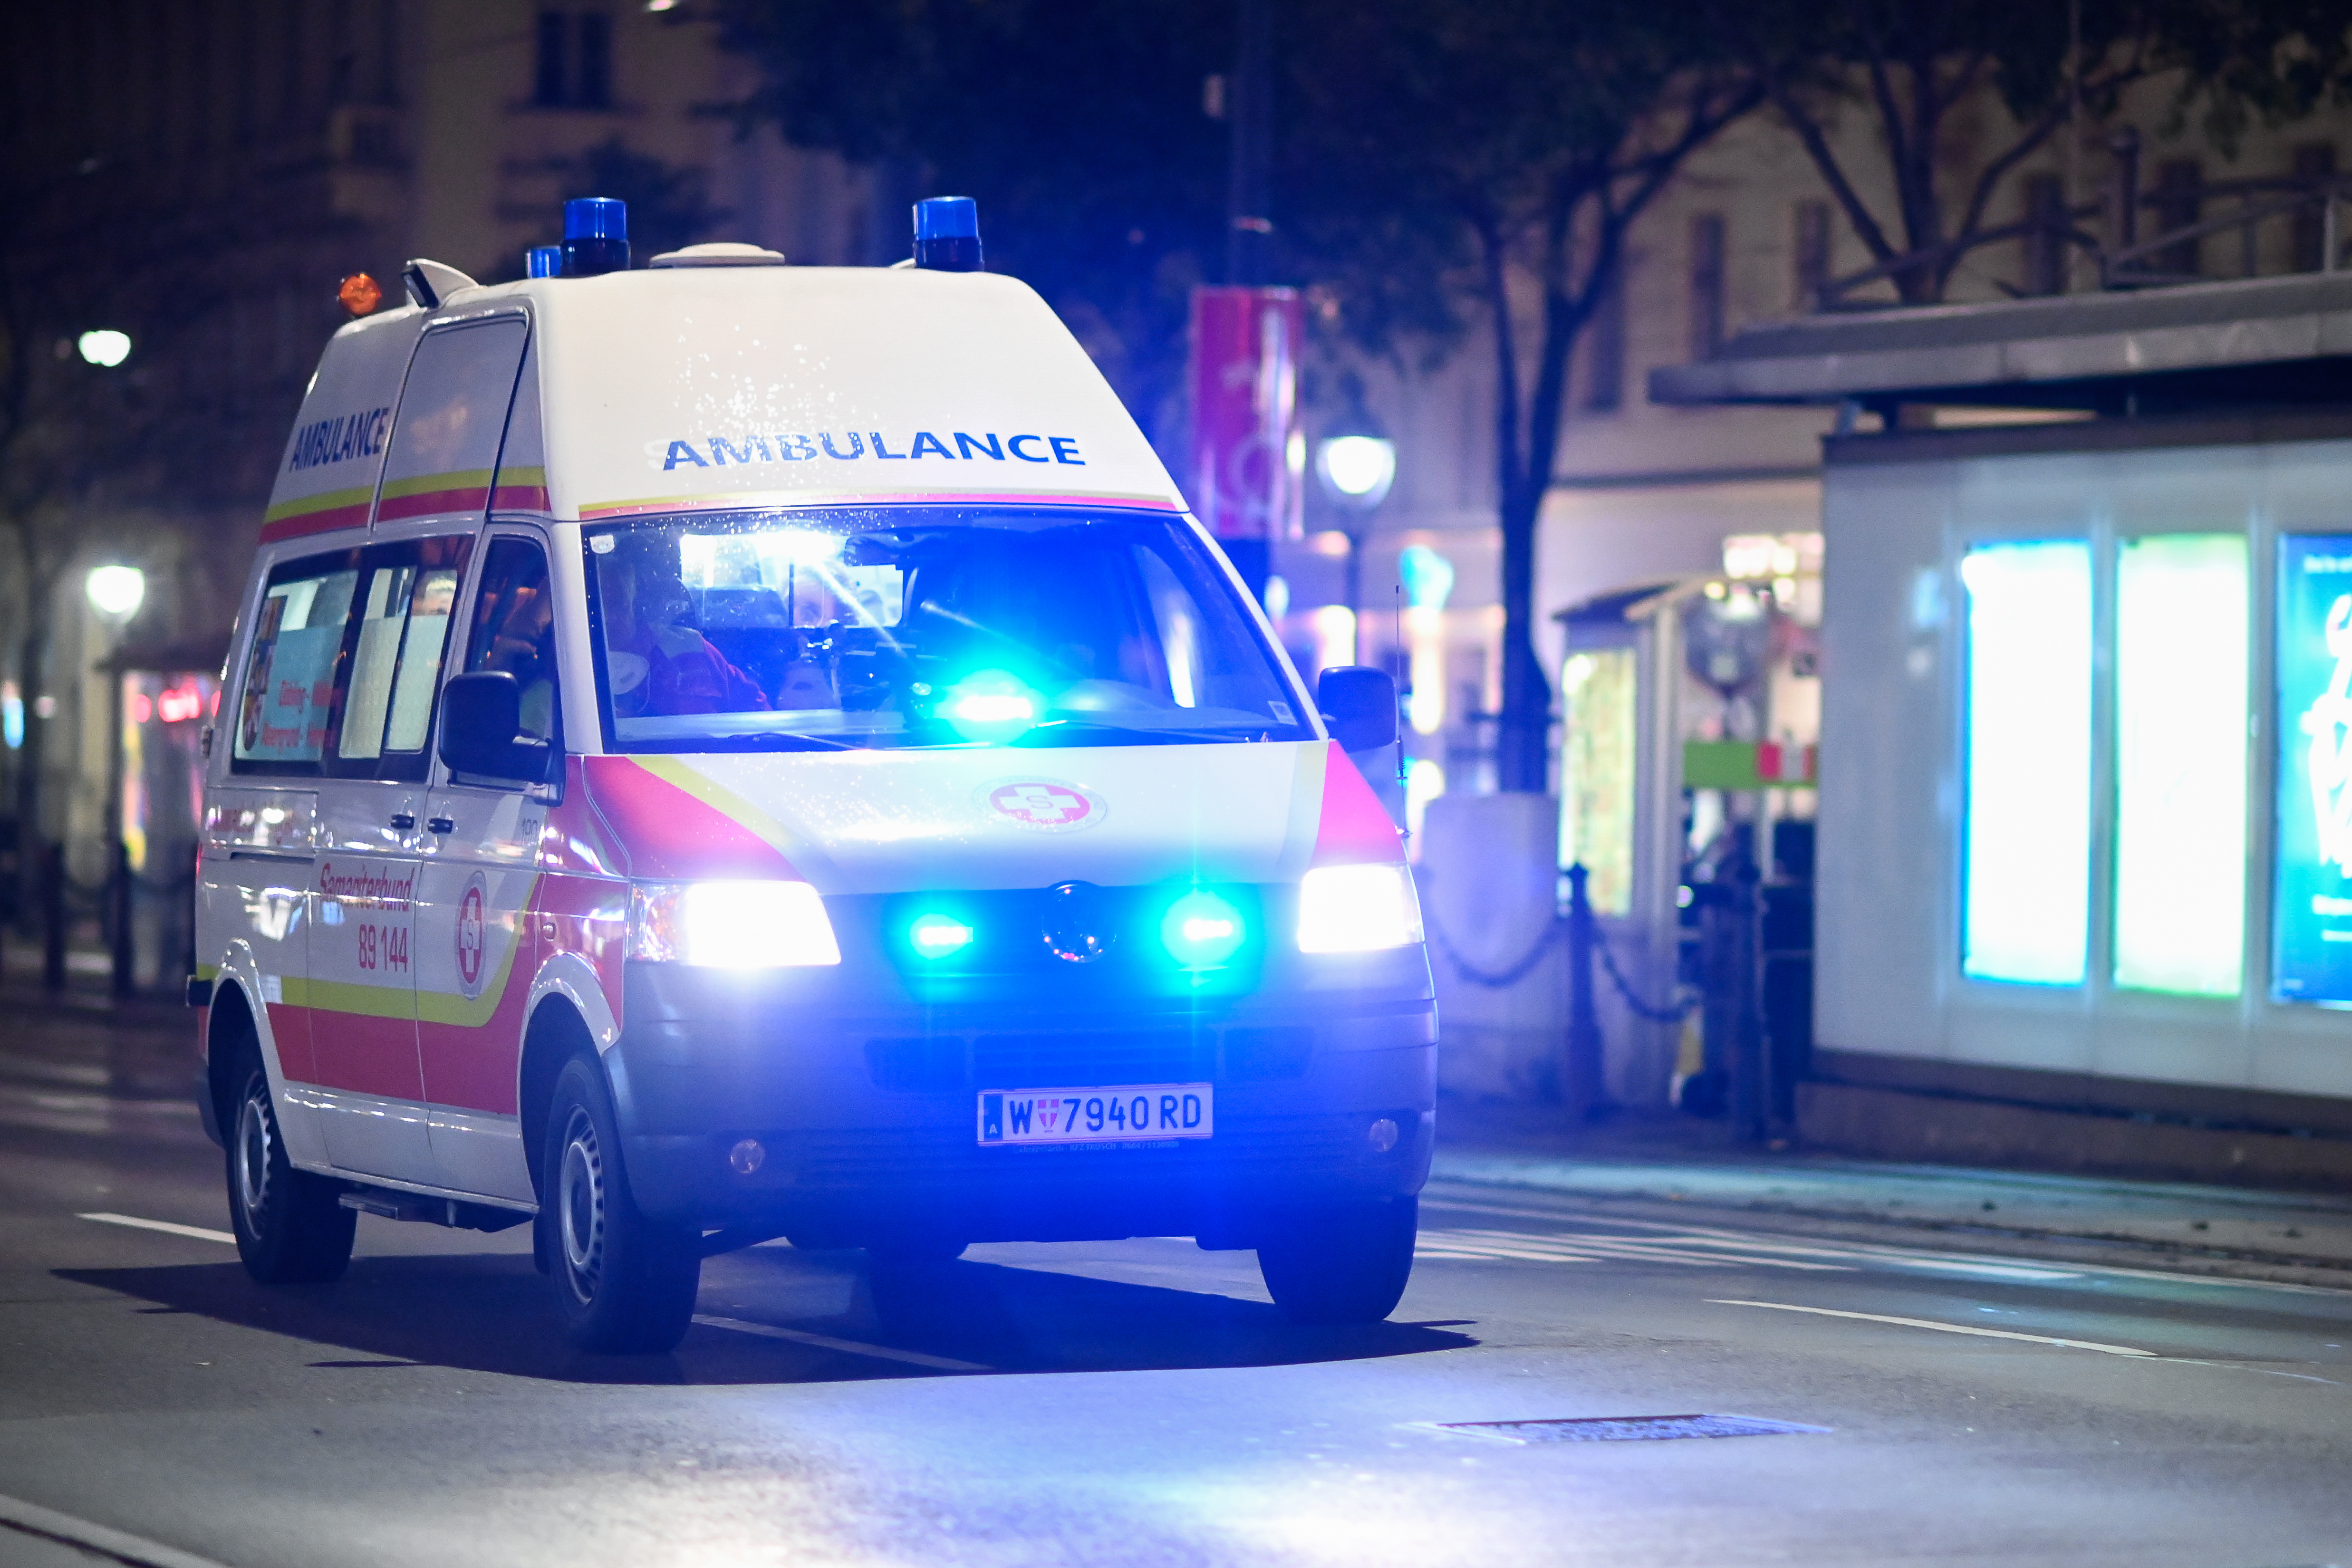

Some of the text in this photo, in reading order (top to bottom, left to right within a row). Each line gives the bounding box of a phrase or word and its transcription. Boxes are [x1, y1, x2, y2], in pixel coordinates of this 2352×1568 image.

[290, 408, 389, 471] AMBULANCE
[663, 432, 1086, 471] AMBULANCE
[359, 924, 408, 972] 89 144
[989, 1124, 998, 1134] A
[1009, 1094, 1200, 1134] W 7940 RD
